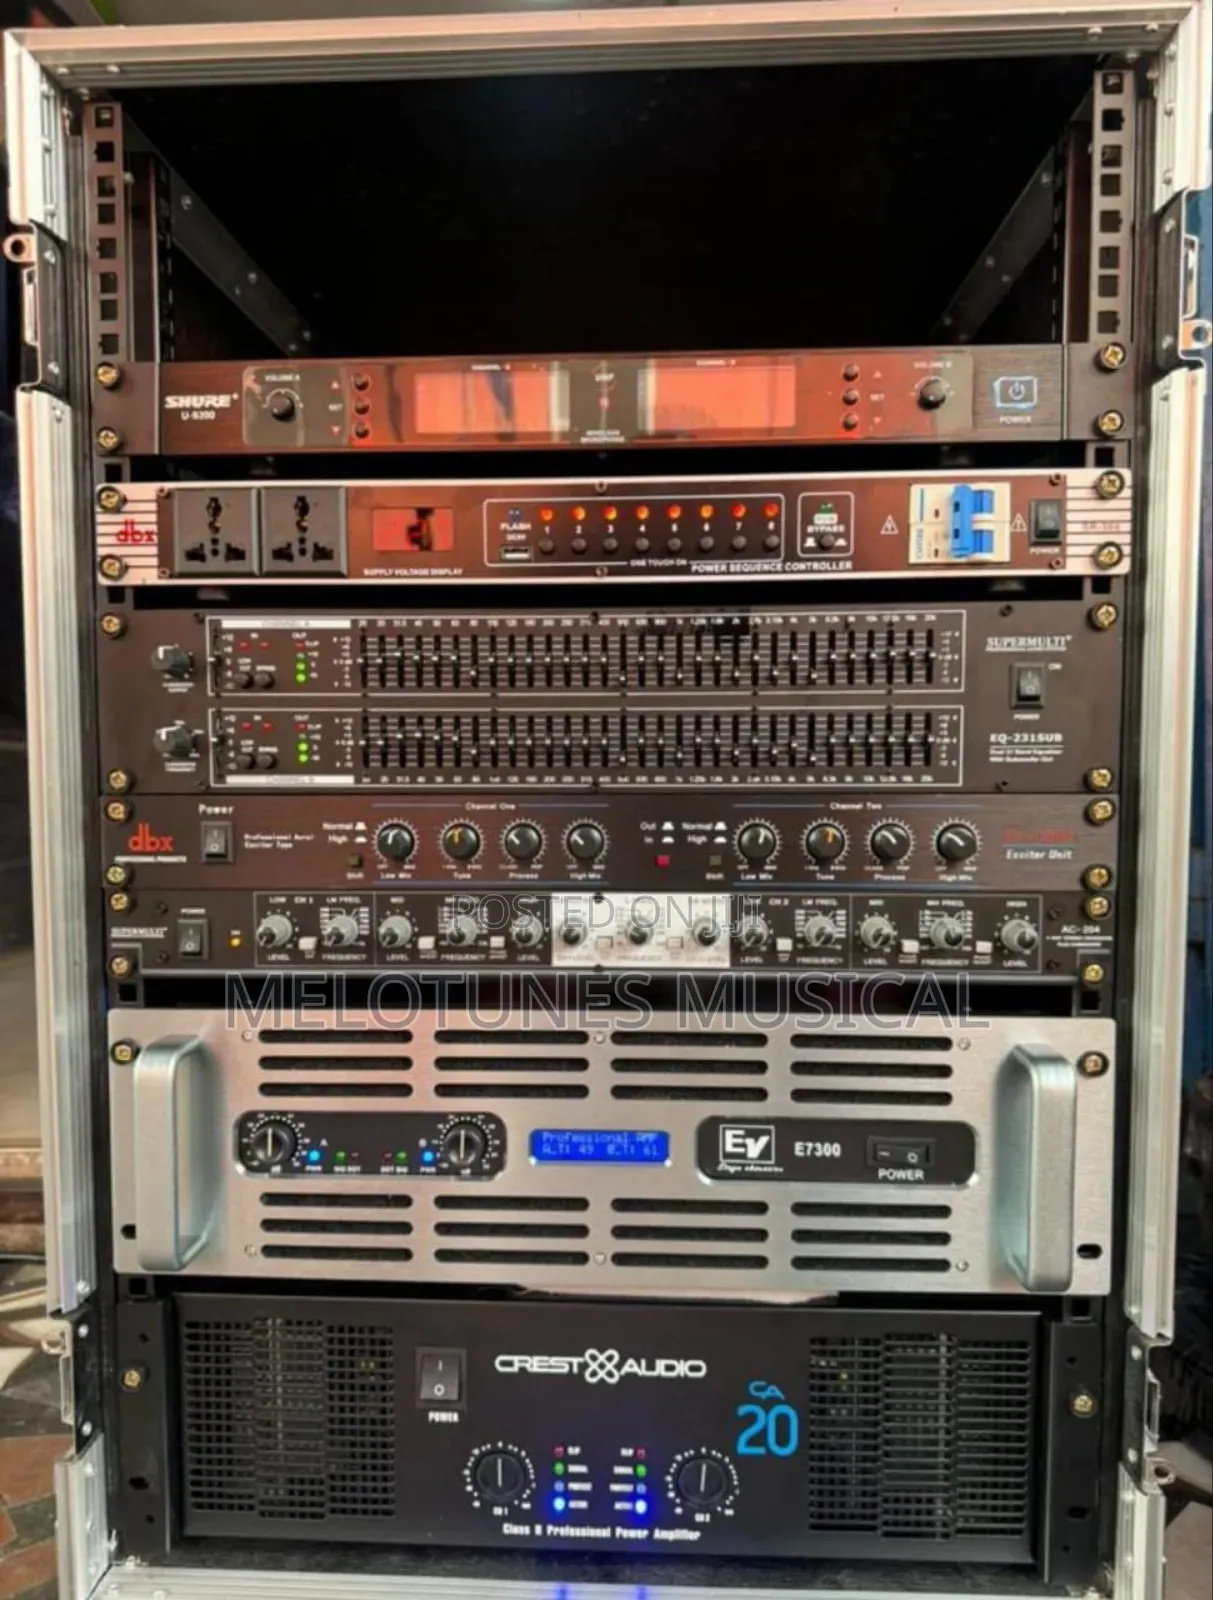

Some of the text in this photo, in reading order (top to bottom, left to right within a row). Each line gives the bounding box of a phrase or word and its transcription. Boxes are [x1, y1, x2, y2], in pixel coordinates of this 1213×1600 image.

[164, 394, 231, 409] SHURE
[115, 519, 156, 545] dbx
[691, 561, 852, 573] POWER SEQUENCE CONTROLLER
[198, 804, 235, 815] Power
[322, 822, 353, 831] Normal
[682, 822, 713, 831] Normal
[127, 820, 174, 852] dbx
[328, 835, 348, 845] High
[687, 835, 708, 845] High
[794, 1141, 841, 1157] E7300
[878, 1169, 924, 1180] POWER
[494, 1354, 707, 1378] CREST AUDIO
[428, 1411, 459, 1423] POWER
[737, 1404, 799, 1456] 20
[502, 1523, 531, 1536] Class
[546, 1524, 611, 1539] Professional
[615, 1526, 649, 1540] Power
[653, 1528, 701, 1541] Amplifier
